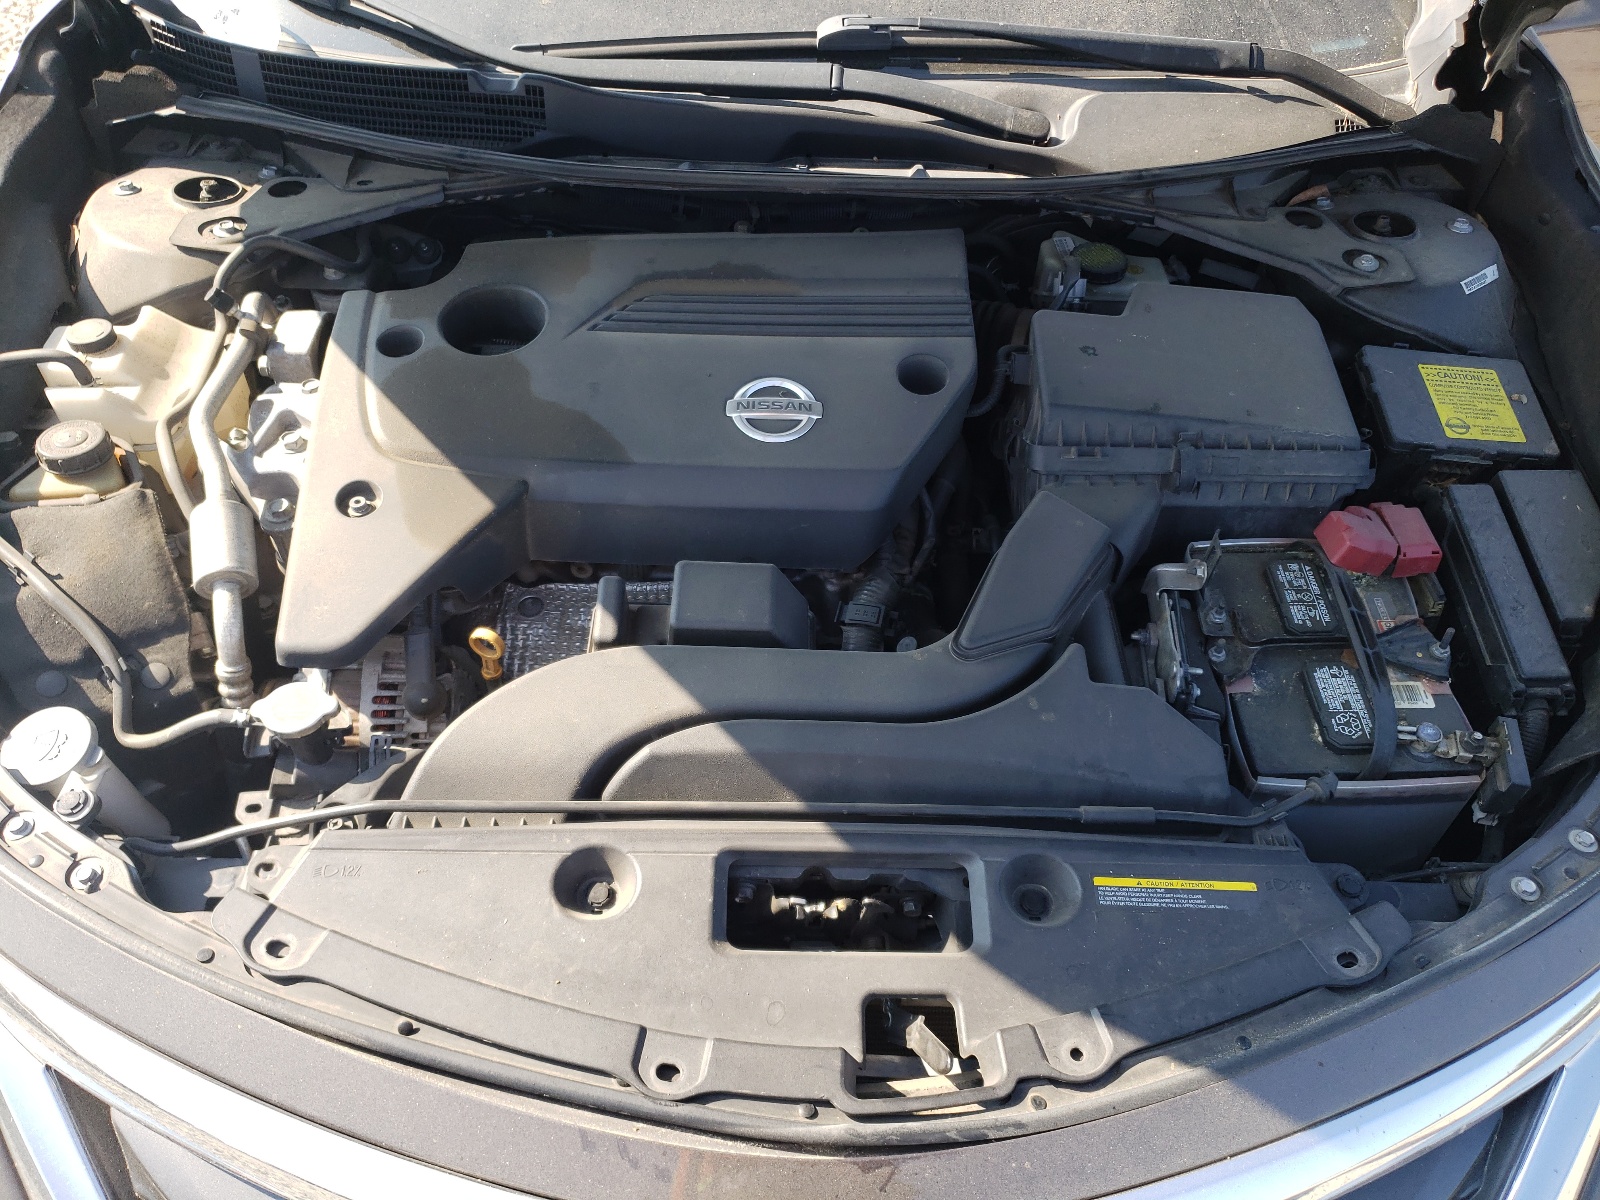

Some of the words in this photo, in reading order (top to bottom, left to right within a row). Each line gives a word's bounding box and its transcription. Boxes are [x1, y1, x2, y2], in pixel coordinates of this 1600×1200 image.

[736, 400, 813, 412] NISSAN
[1306, 571, 1321, 595] DANGER
[1317, 599, 1332, 623] POISON
